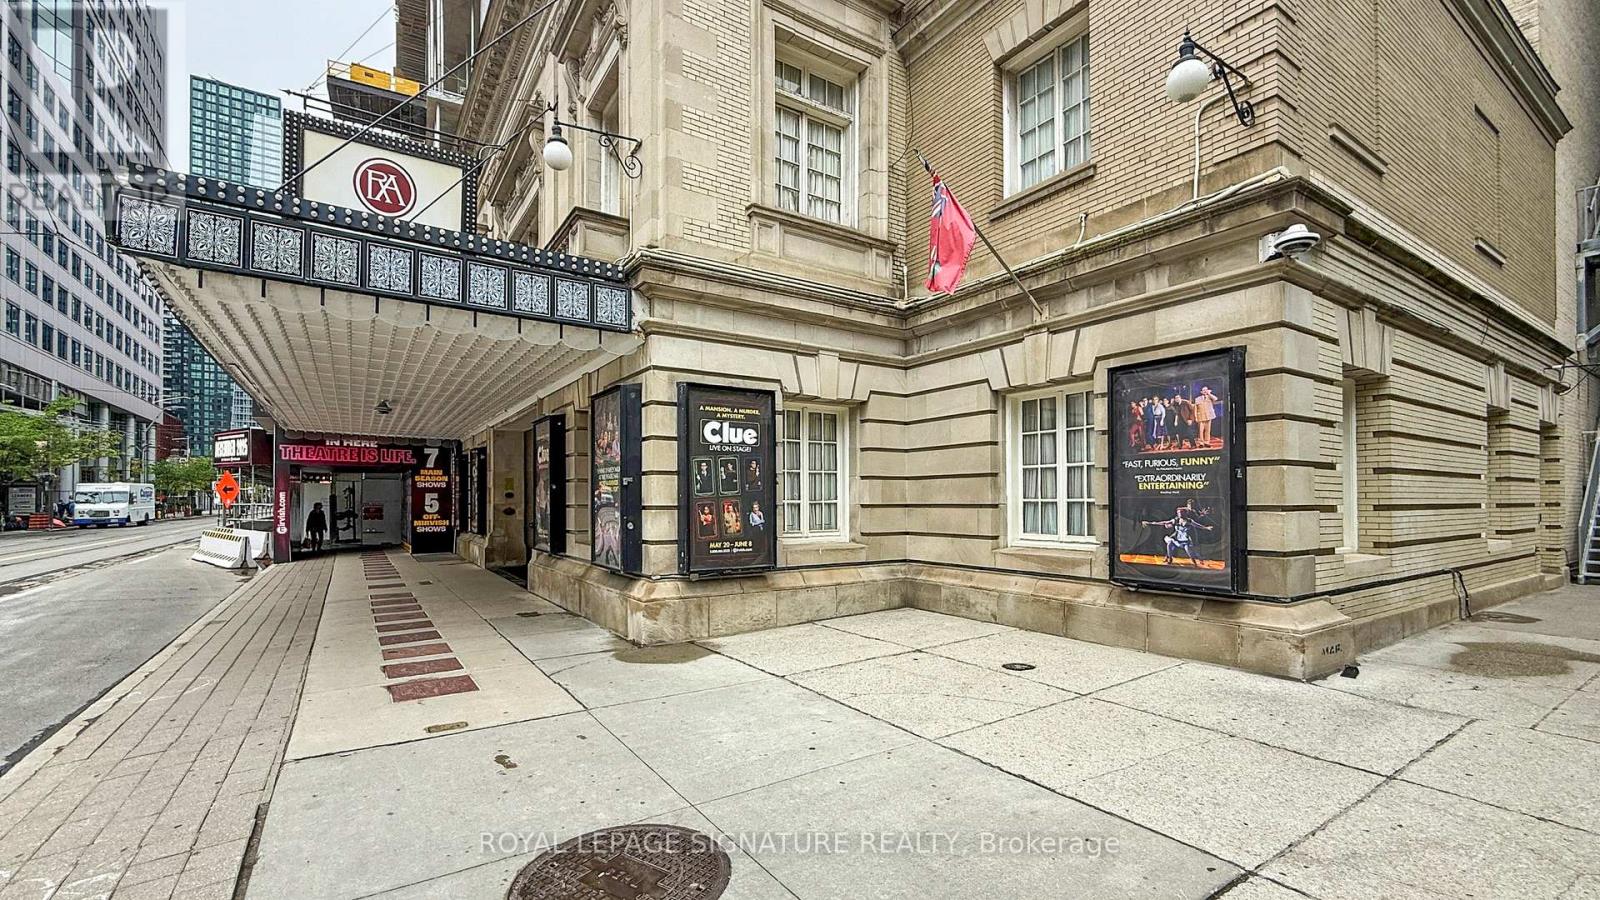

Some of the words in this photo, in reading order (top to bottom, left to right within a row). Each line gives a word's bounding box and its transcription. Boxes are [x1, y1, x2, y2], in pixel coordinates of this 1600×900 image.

[703, 421, 758, 445] Clue
[279, 445, 359, 462] THEATRE
[360, 448, 379, 463] IS
[380, 449, 417, 465] LIFE.
[424, 448, 439, 468] 7
[1144, 458, 1179, 468] FURIOUS,
[424, 492, 439, 513] 5
[416, 525, 446, 533] SHOWS
